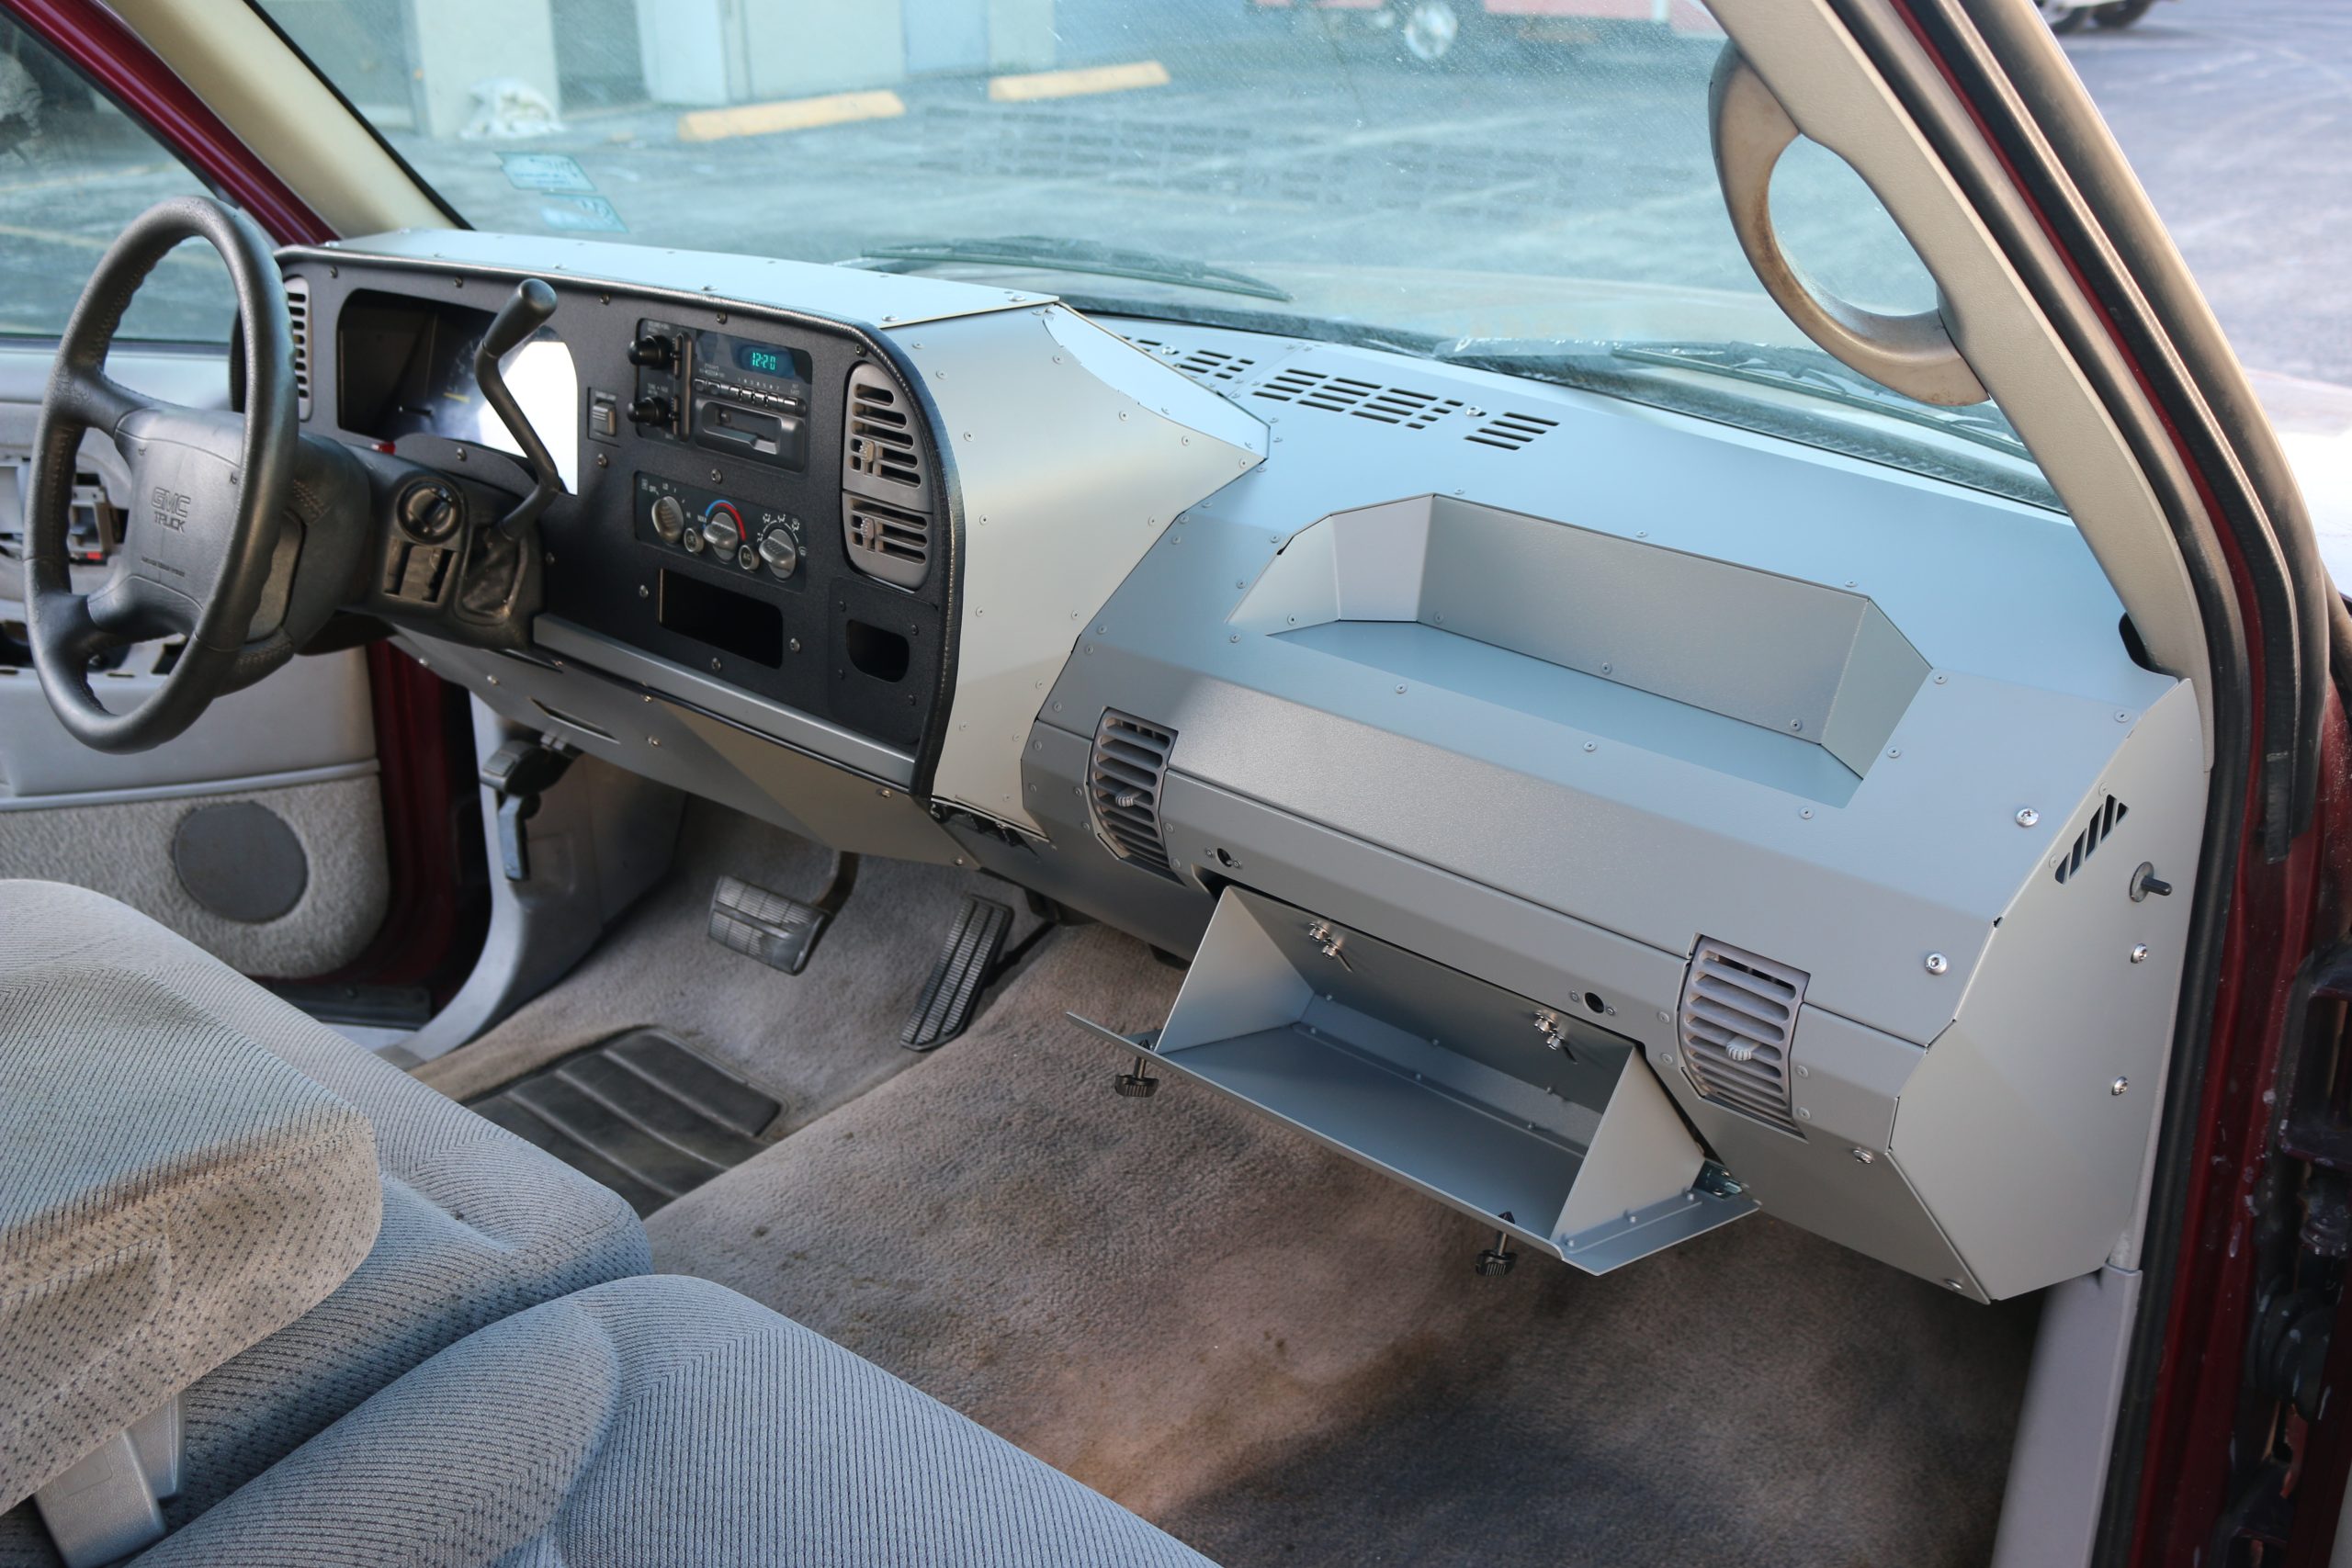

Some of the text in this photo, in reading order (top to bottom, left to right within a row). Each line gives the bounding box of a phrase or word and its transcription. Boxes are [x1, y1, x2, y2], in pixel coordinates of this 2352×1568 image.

[752, 352, 776, 371] 12:20
[152, 487, 191, 518] GMC
[153, 512, 187, 534] TRUCK
